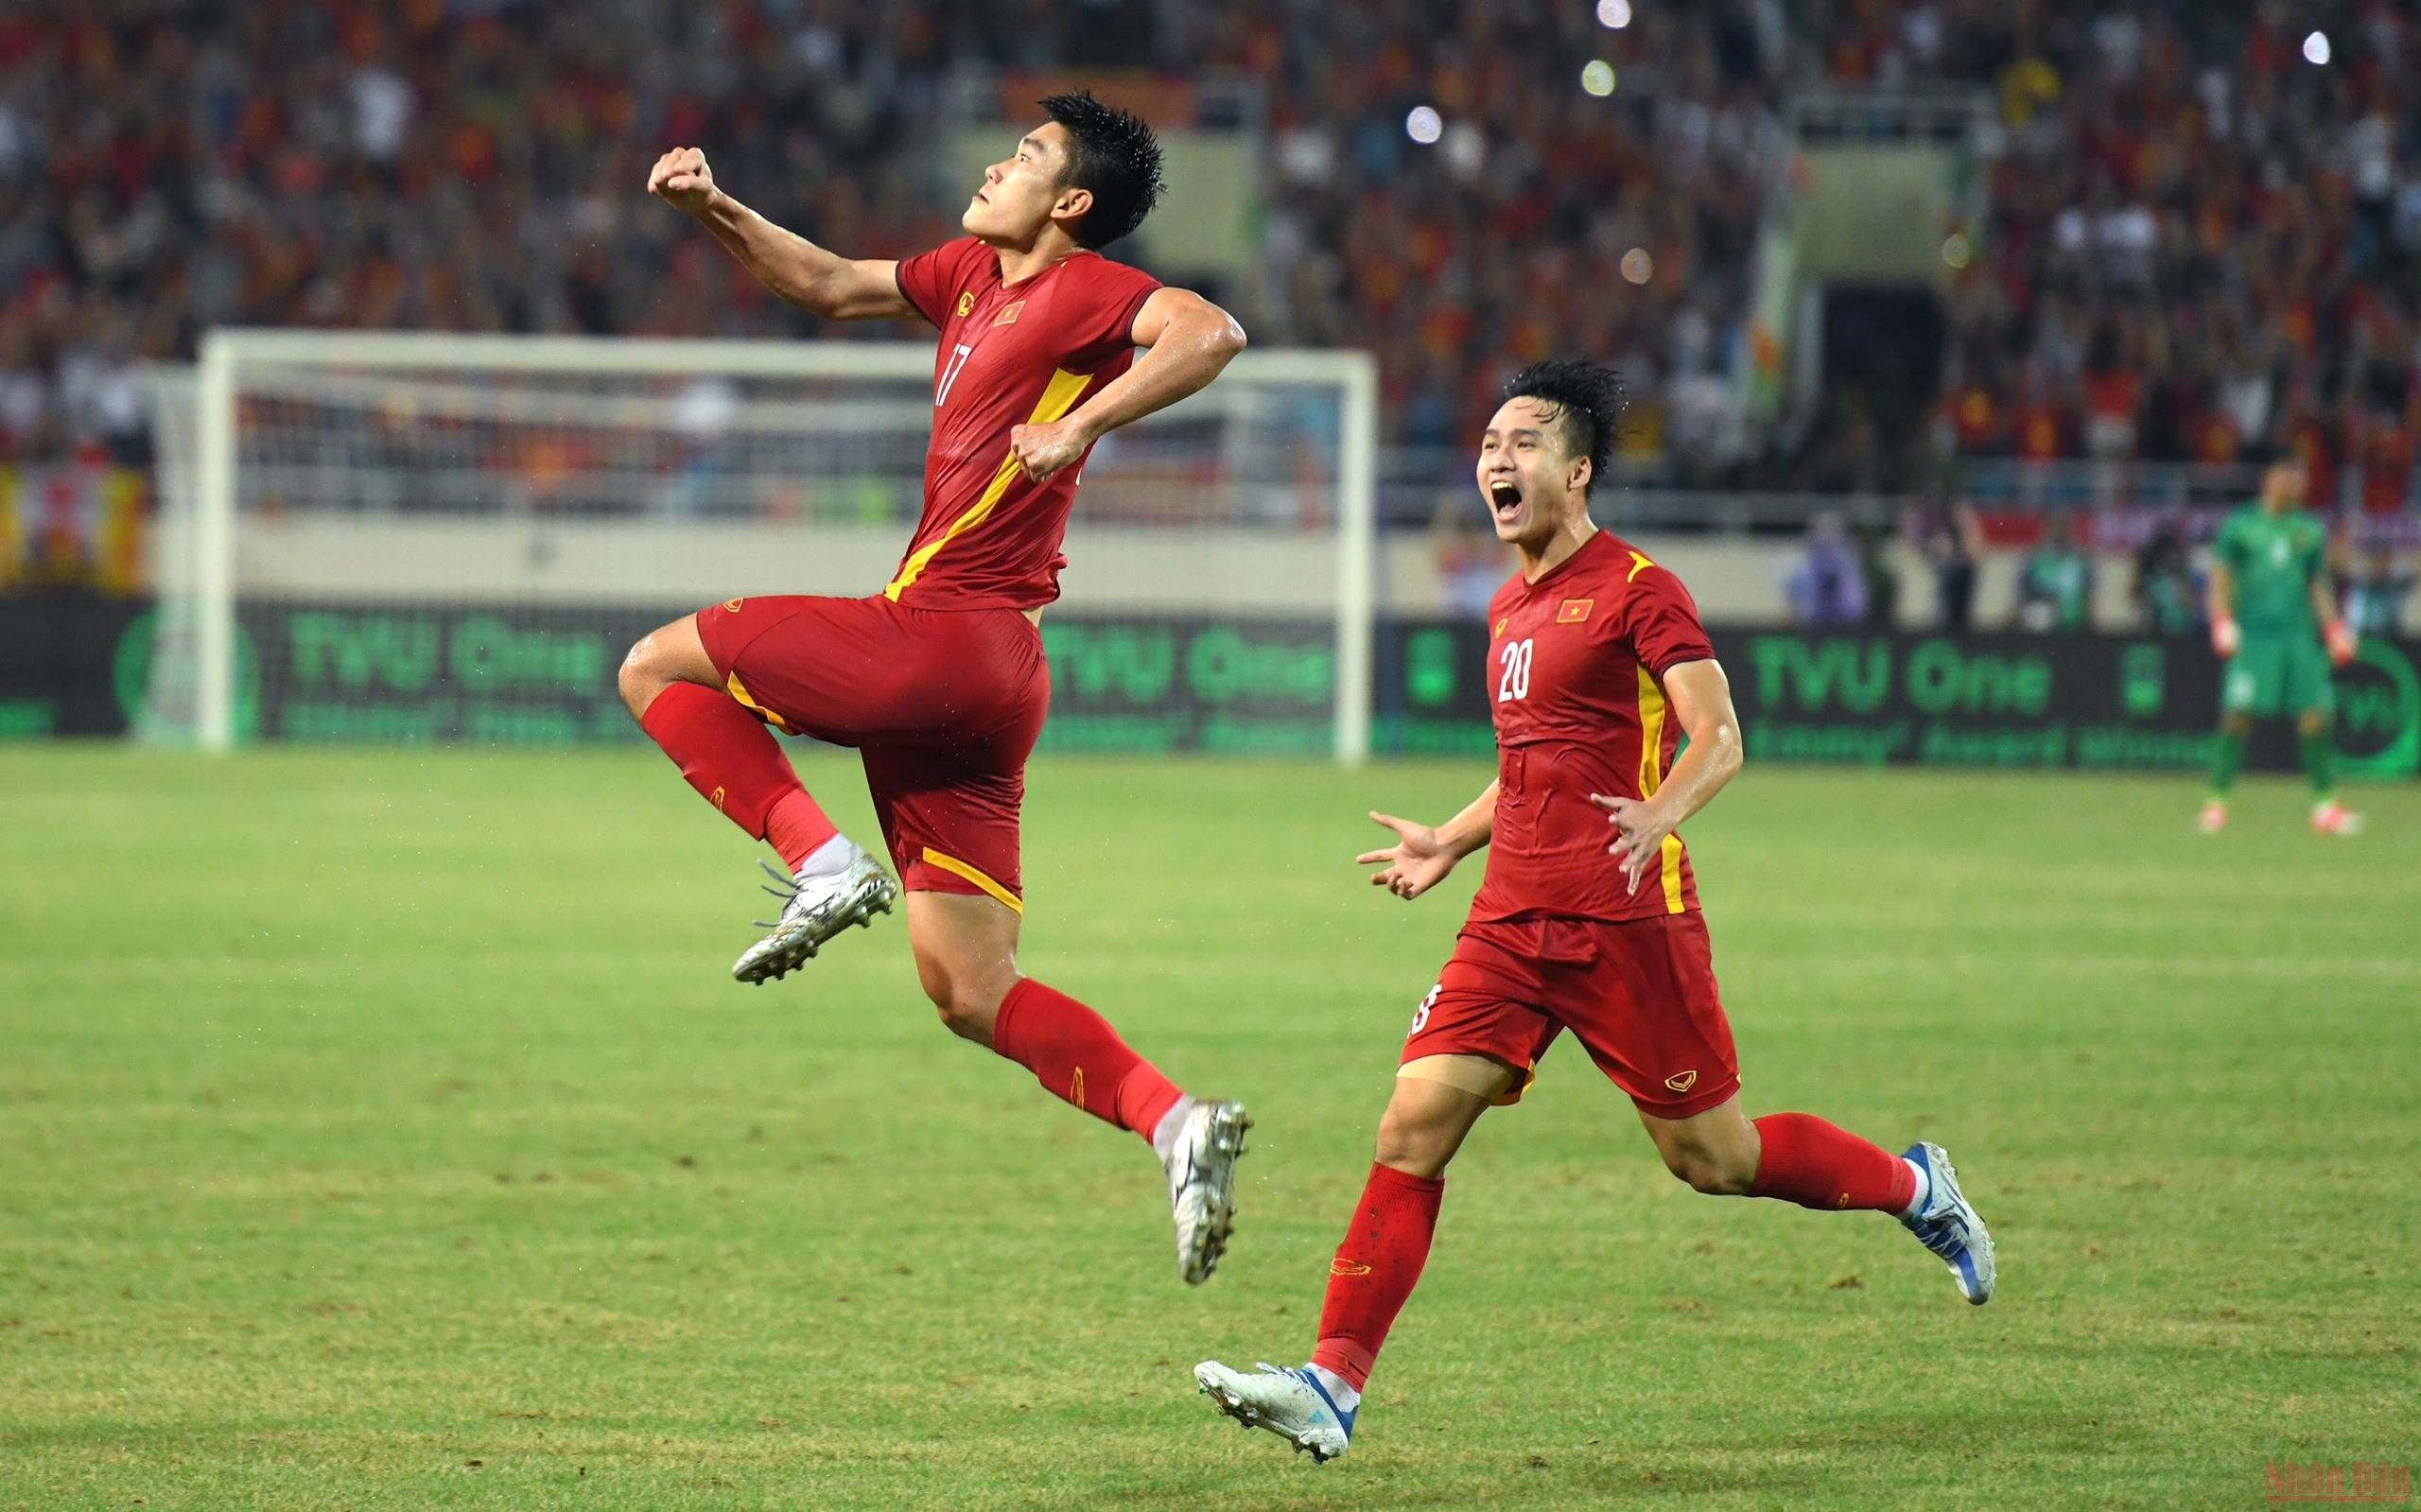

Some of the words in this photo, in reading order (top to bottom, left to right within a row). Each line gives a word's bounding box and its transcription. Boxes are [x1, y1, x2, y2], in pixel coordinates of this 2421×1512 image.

[935, 343, 973, 408] 17
[1498, 638, 1534, 704] 20
[1750, 635, 1890, 711] TVU
[1907, 637, 2052, 711] One
